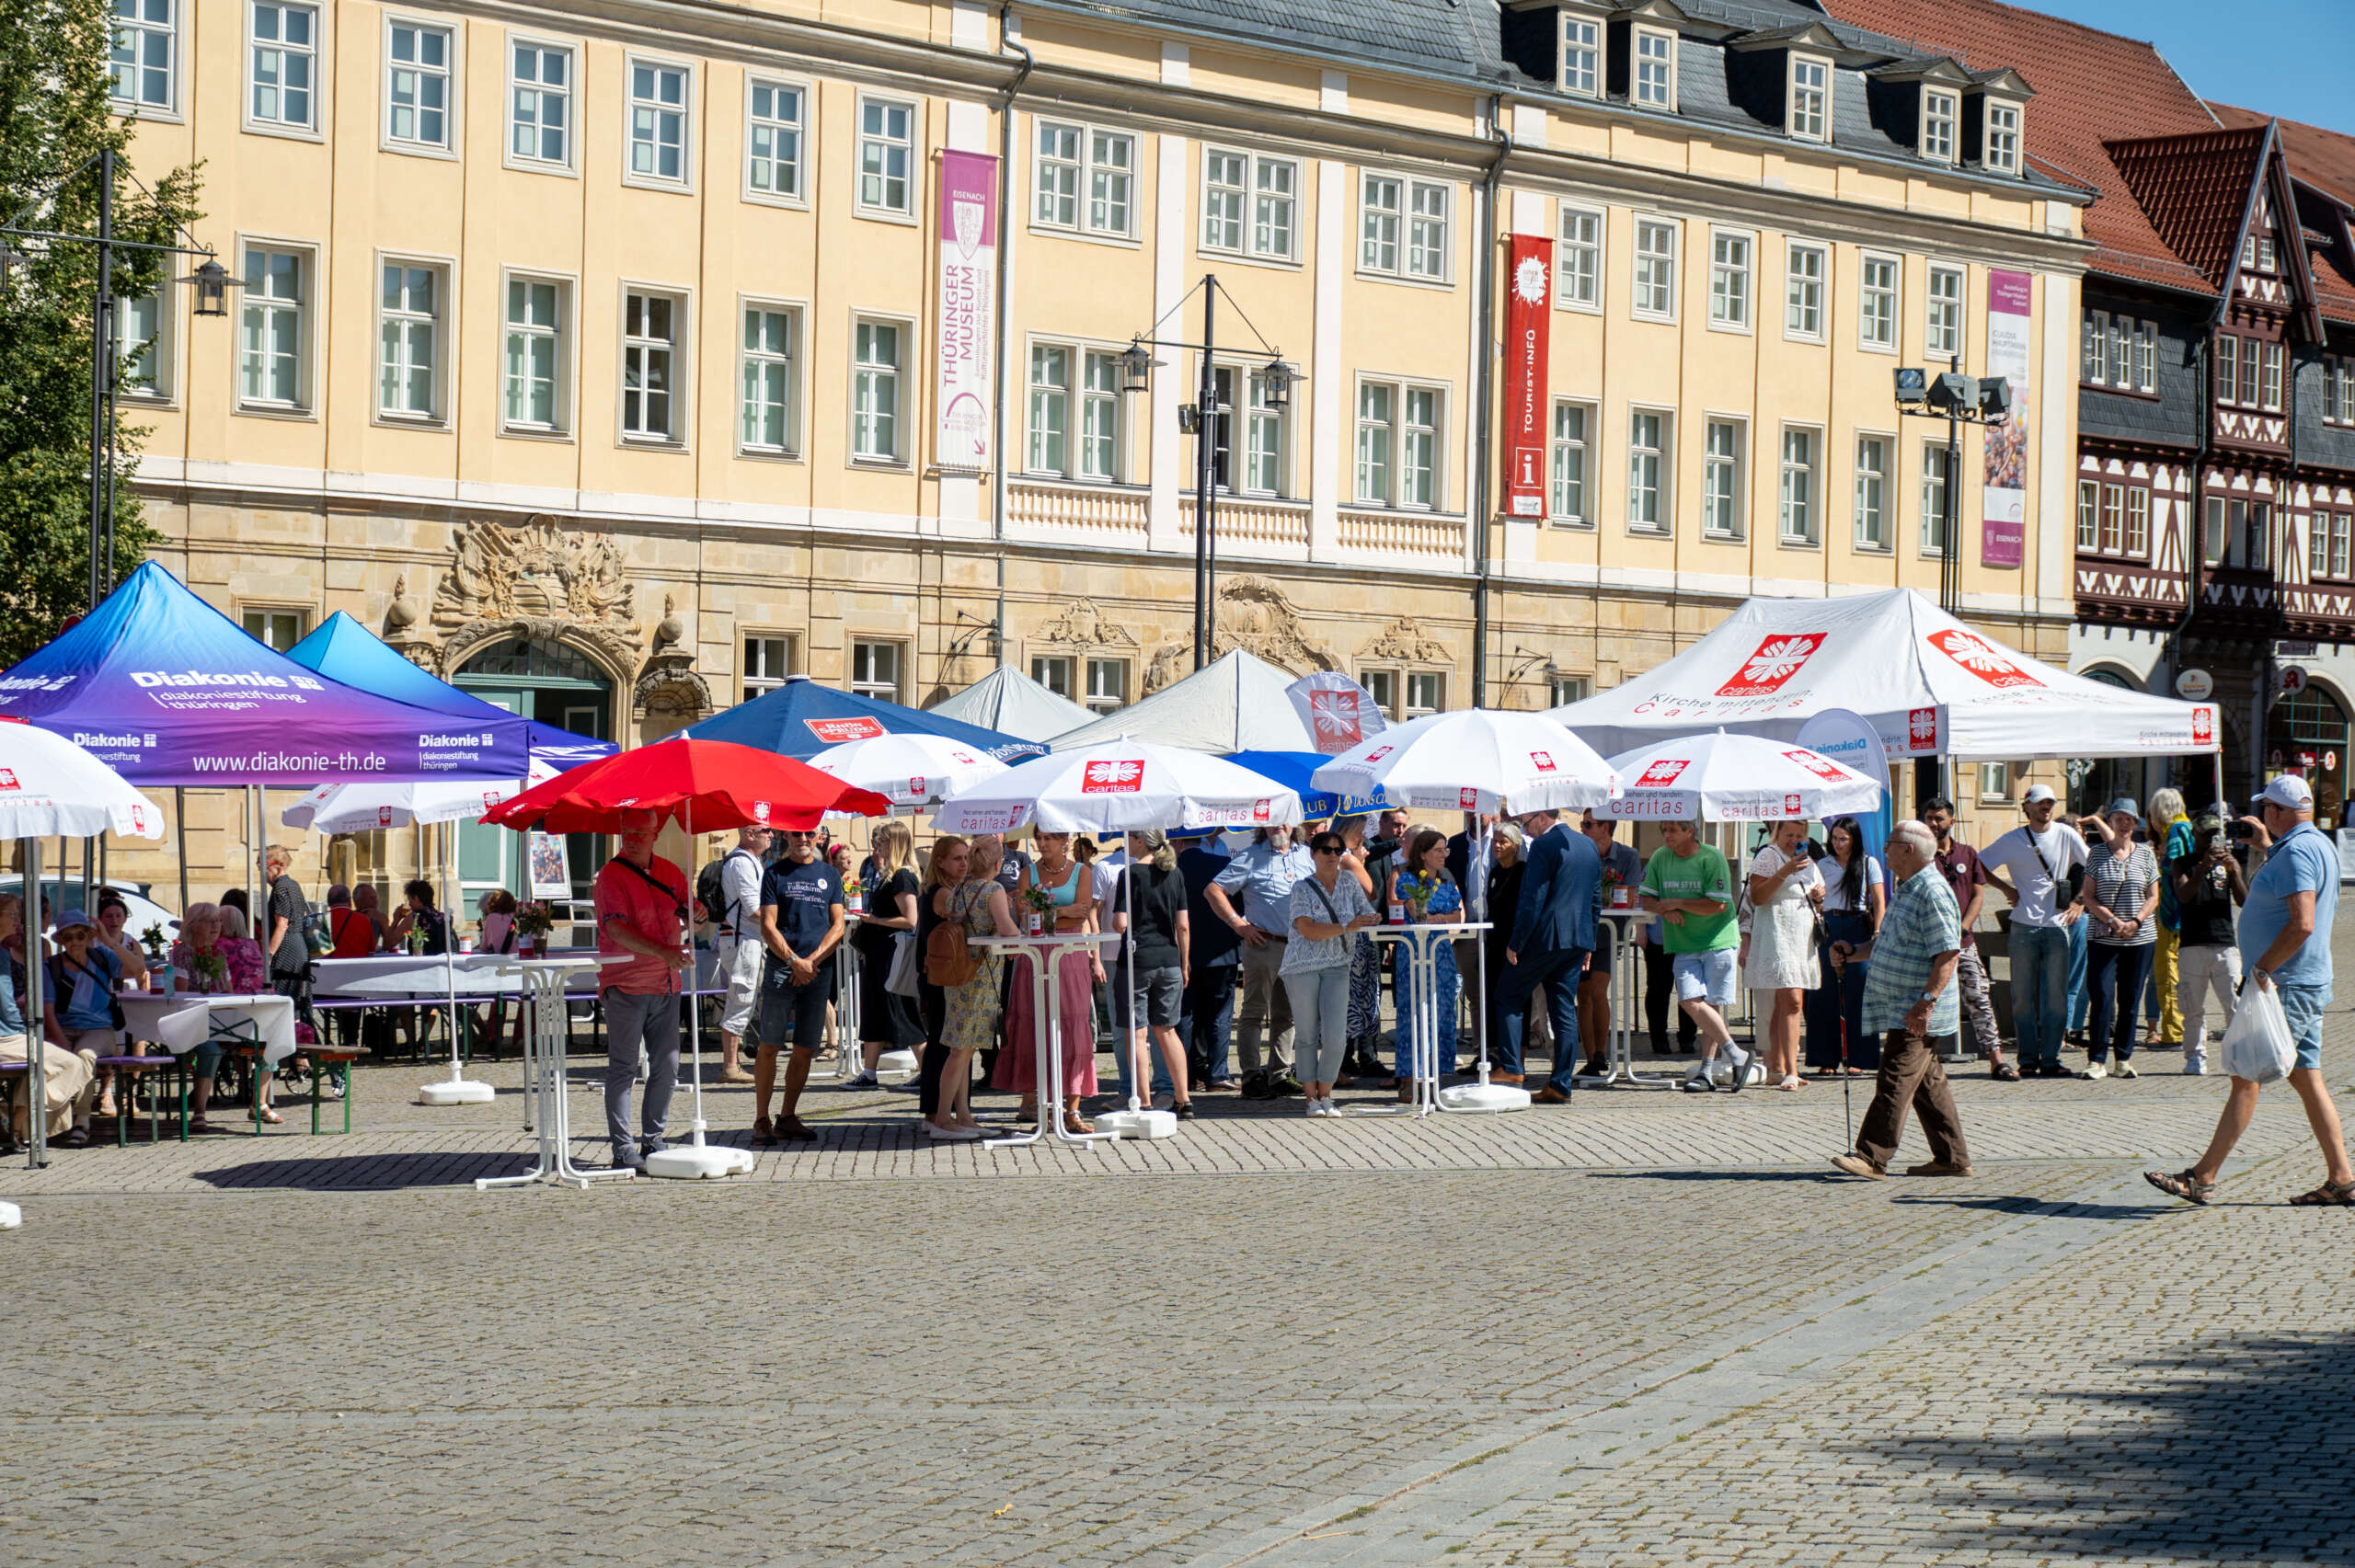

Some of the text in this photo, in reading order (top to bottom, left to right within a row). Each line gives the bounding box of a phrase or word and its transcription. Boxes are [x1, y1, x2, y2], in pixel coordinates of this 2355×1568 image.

[952, 189, 986, 201] EISENACH
[959, 266, 974, 361] MUSEUM
[942, 264, 959, 387] THÜRINGER
[1523, 328, 1536, 434] TOURIST-INFO
[129, 670, 290, 688] Diakonie
[159, 690, 308, 704] diakoniestiftung
[1720, 684, 1776, 696] caritas
[168, 700, 260, 711] thüringen
[1648, 689, 1814, 709] Kirche mittendrin.
[74, 732, 141, 748] Diakonie
[419, 733, 479, 748] Diakonie
[192, 750, 386, 773] www.diakonie-th.de
[422, 750, 479, 761] diakoniestiftung
[422, 760, 458, 771] thüringen
[1086, 784, 1136, 793] caritas
[1611, 797, 1683, 815] caritas
[1721, 804, 1779, 818] caritas
[961, 816, 1006, 830] caritas
[1198, 808, 1247, 823] caritas
